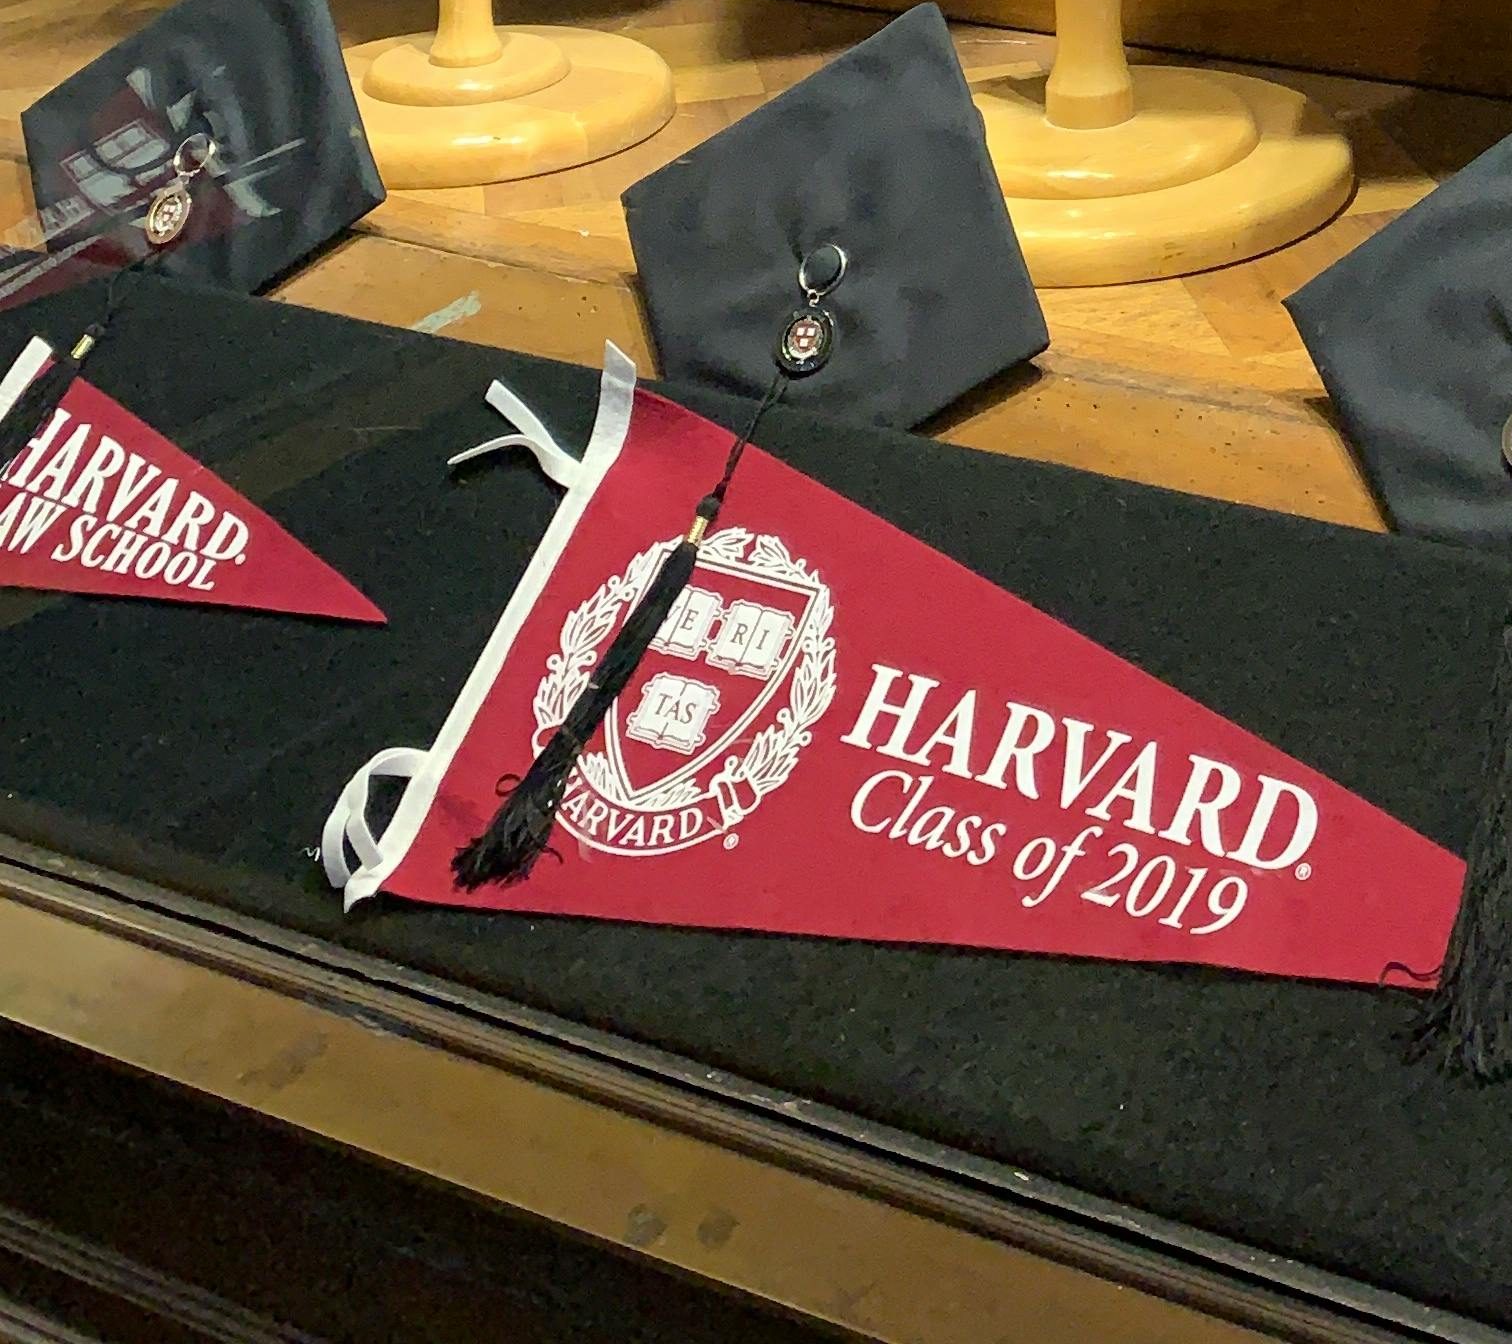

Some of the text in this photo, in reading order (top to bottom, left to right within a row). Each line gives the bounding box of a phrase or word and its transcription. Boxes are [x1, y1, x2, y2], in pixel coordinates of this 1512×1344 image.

[51, 515, 217, 592] SCHOOL
[731, 622, 770, 650] RI
[656, 693, 698, 725] TAS
[839, 663, 1320, 872] HARVARD
[852, 770, 1249, 935] Class of 2019
